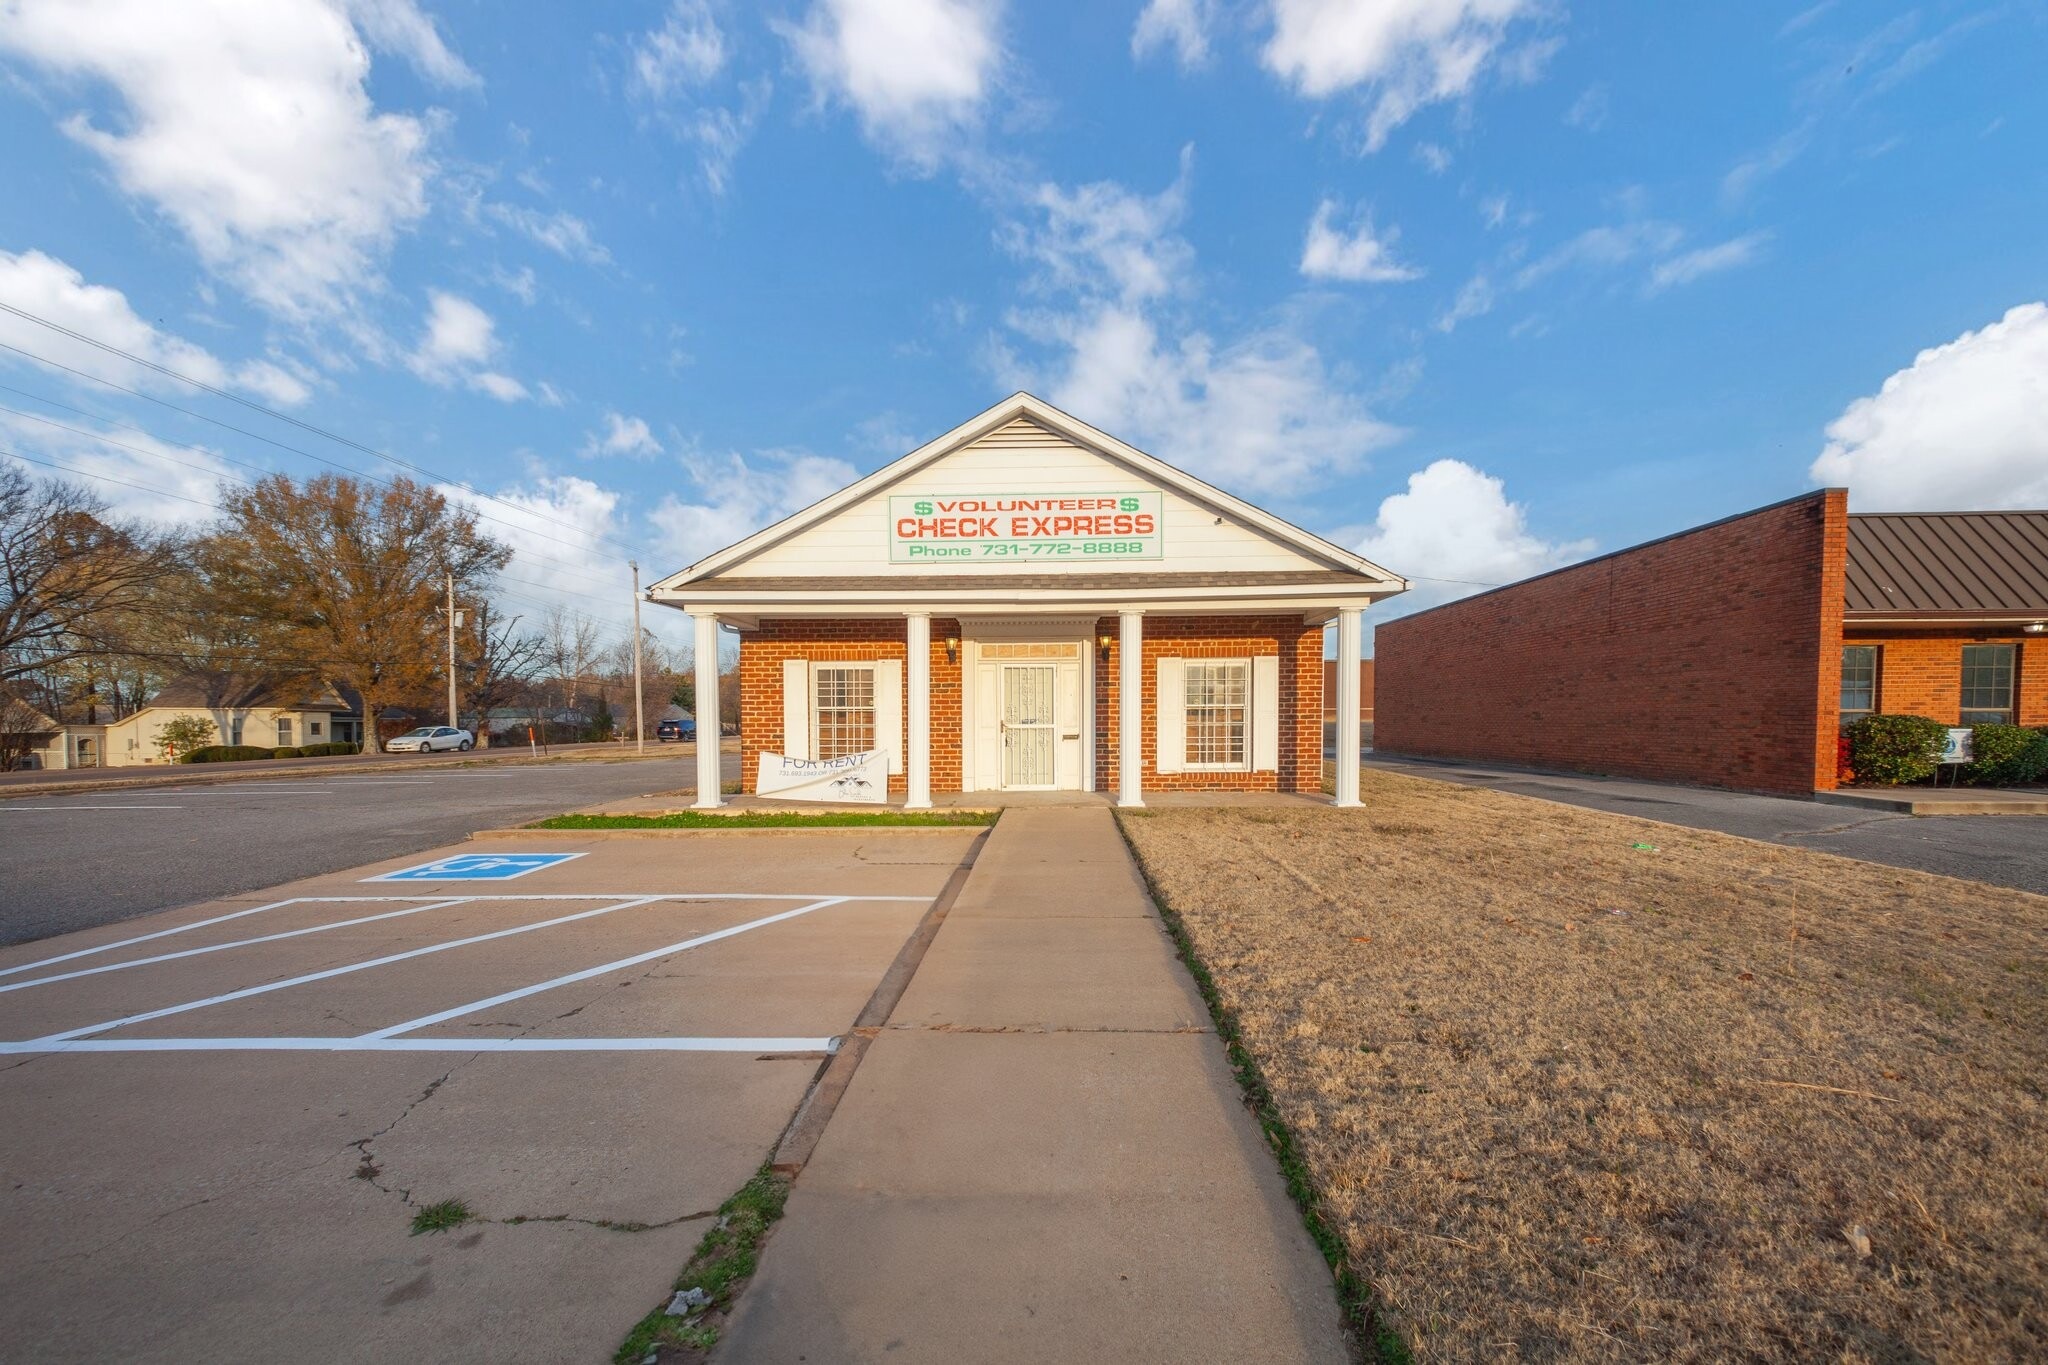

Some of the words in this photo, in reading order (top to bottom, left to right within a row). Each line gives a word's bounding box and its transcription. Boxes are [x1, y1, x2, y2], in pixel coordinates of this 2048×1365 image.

[897, 517, 999, 538] CHECK
[1011, 514, 1154, 537] EXPRESS
[909, 545, 972, 556] Phone
[982, 542, 1143, 555] 731-772-8888
[783, 756, 817, 769] FOR
[823, 754, 867, 768] RENT
